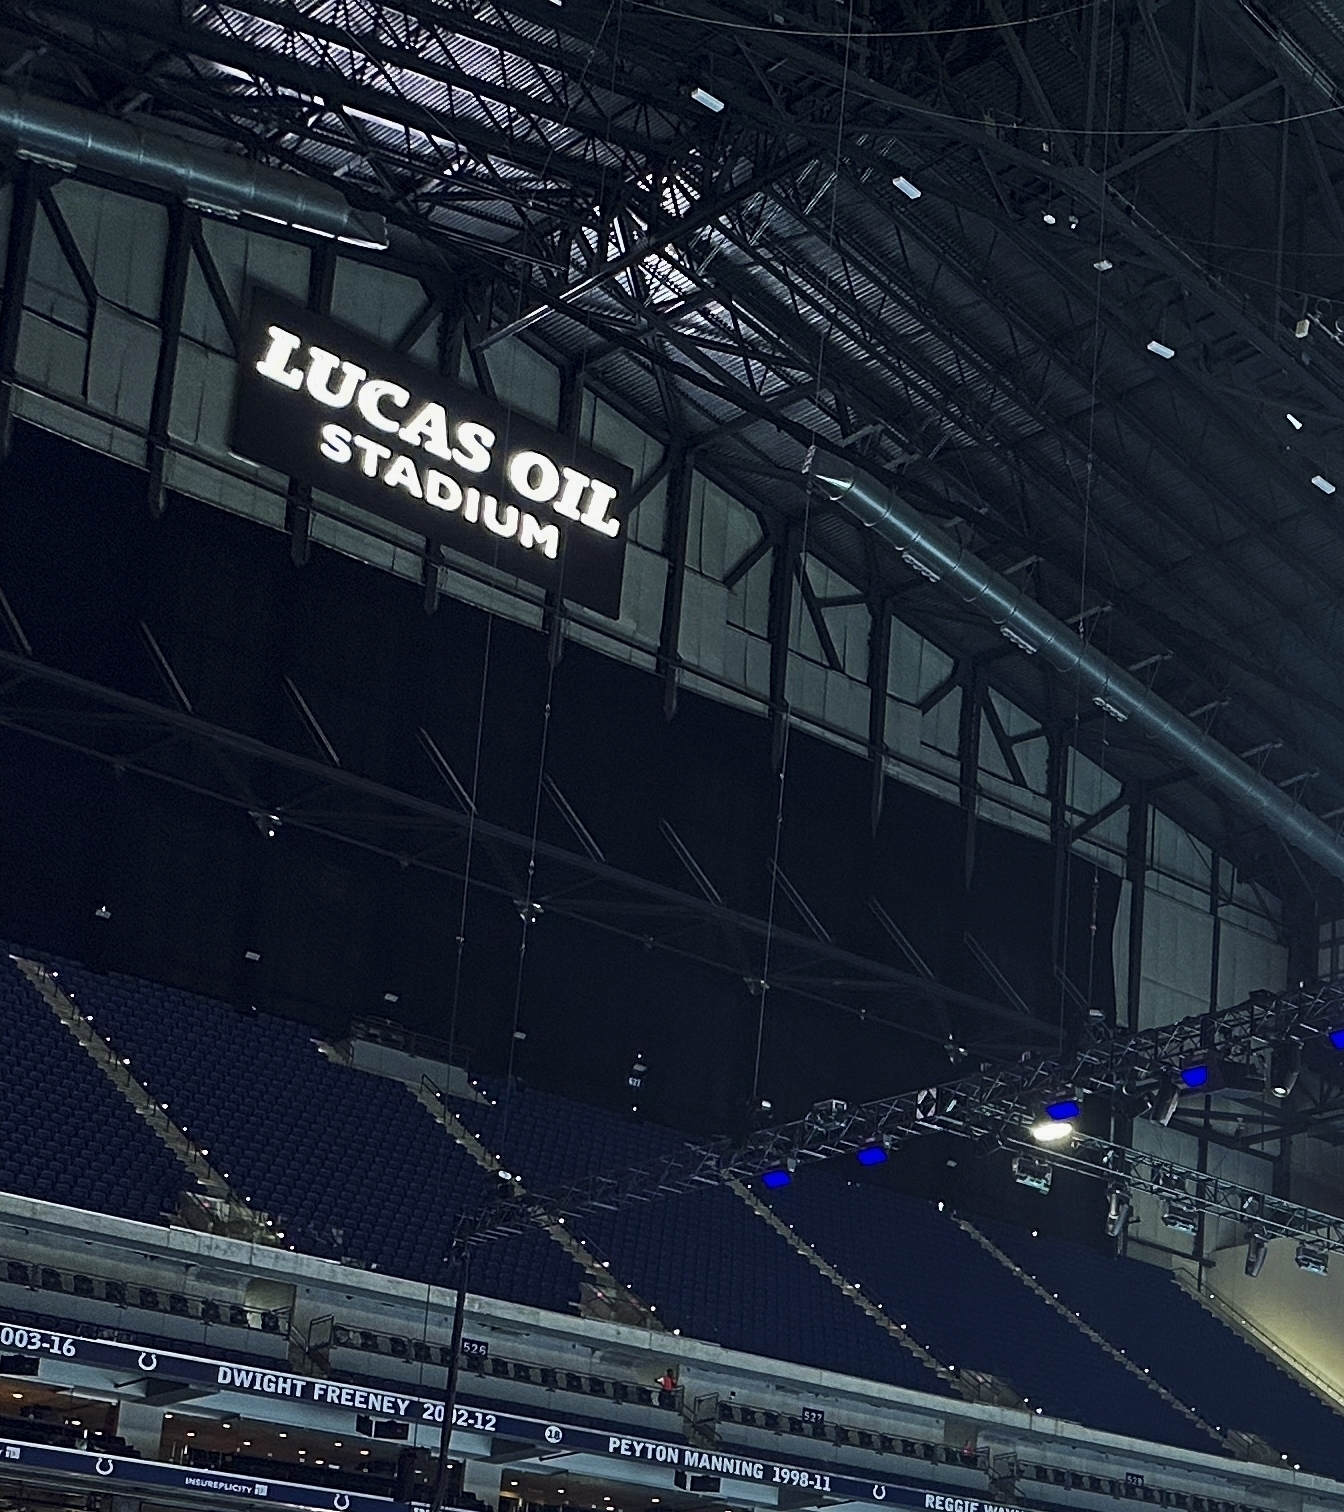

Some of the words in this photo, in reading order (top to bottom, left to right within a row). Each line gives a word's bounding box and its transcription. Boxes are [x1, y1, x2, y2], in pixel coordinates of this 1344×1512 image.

[255, 324, 496, 473] LUCAS
[506, 449, 621, 539] OIL
[319, 422, 562, 560] STADIUM
[217, 1366, 306, 1398] DWIGHT
[312, 1383, 411, 1416] FREENEY
[608, 1437, 680, 1465] PEYTON
[684, 1449, 765, 1480] MANNING
[772, 1466, 832, 1493] 1998-11
